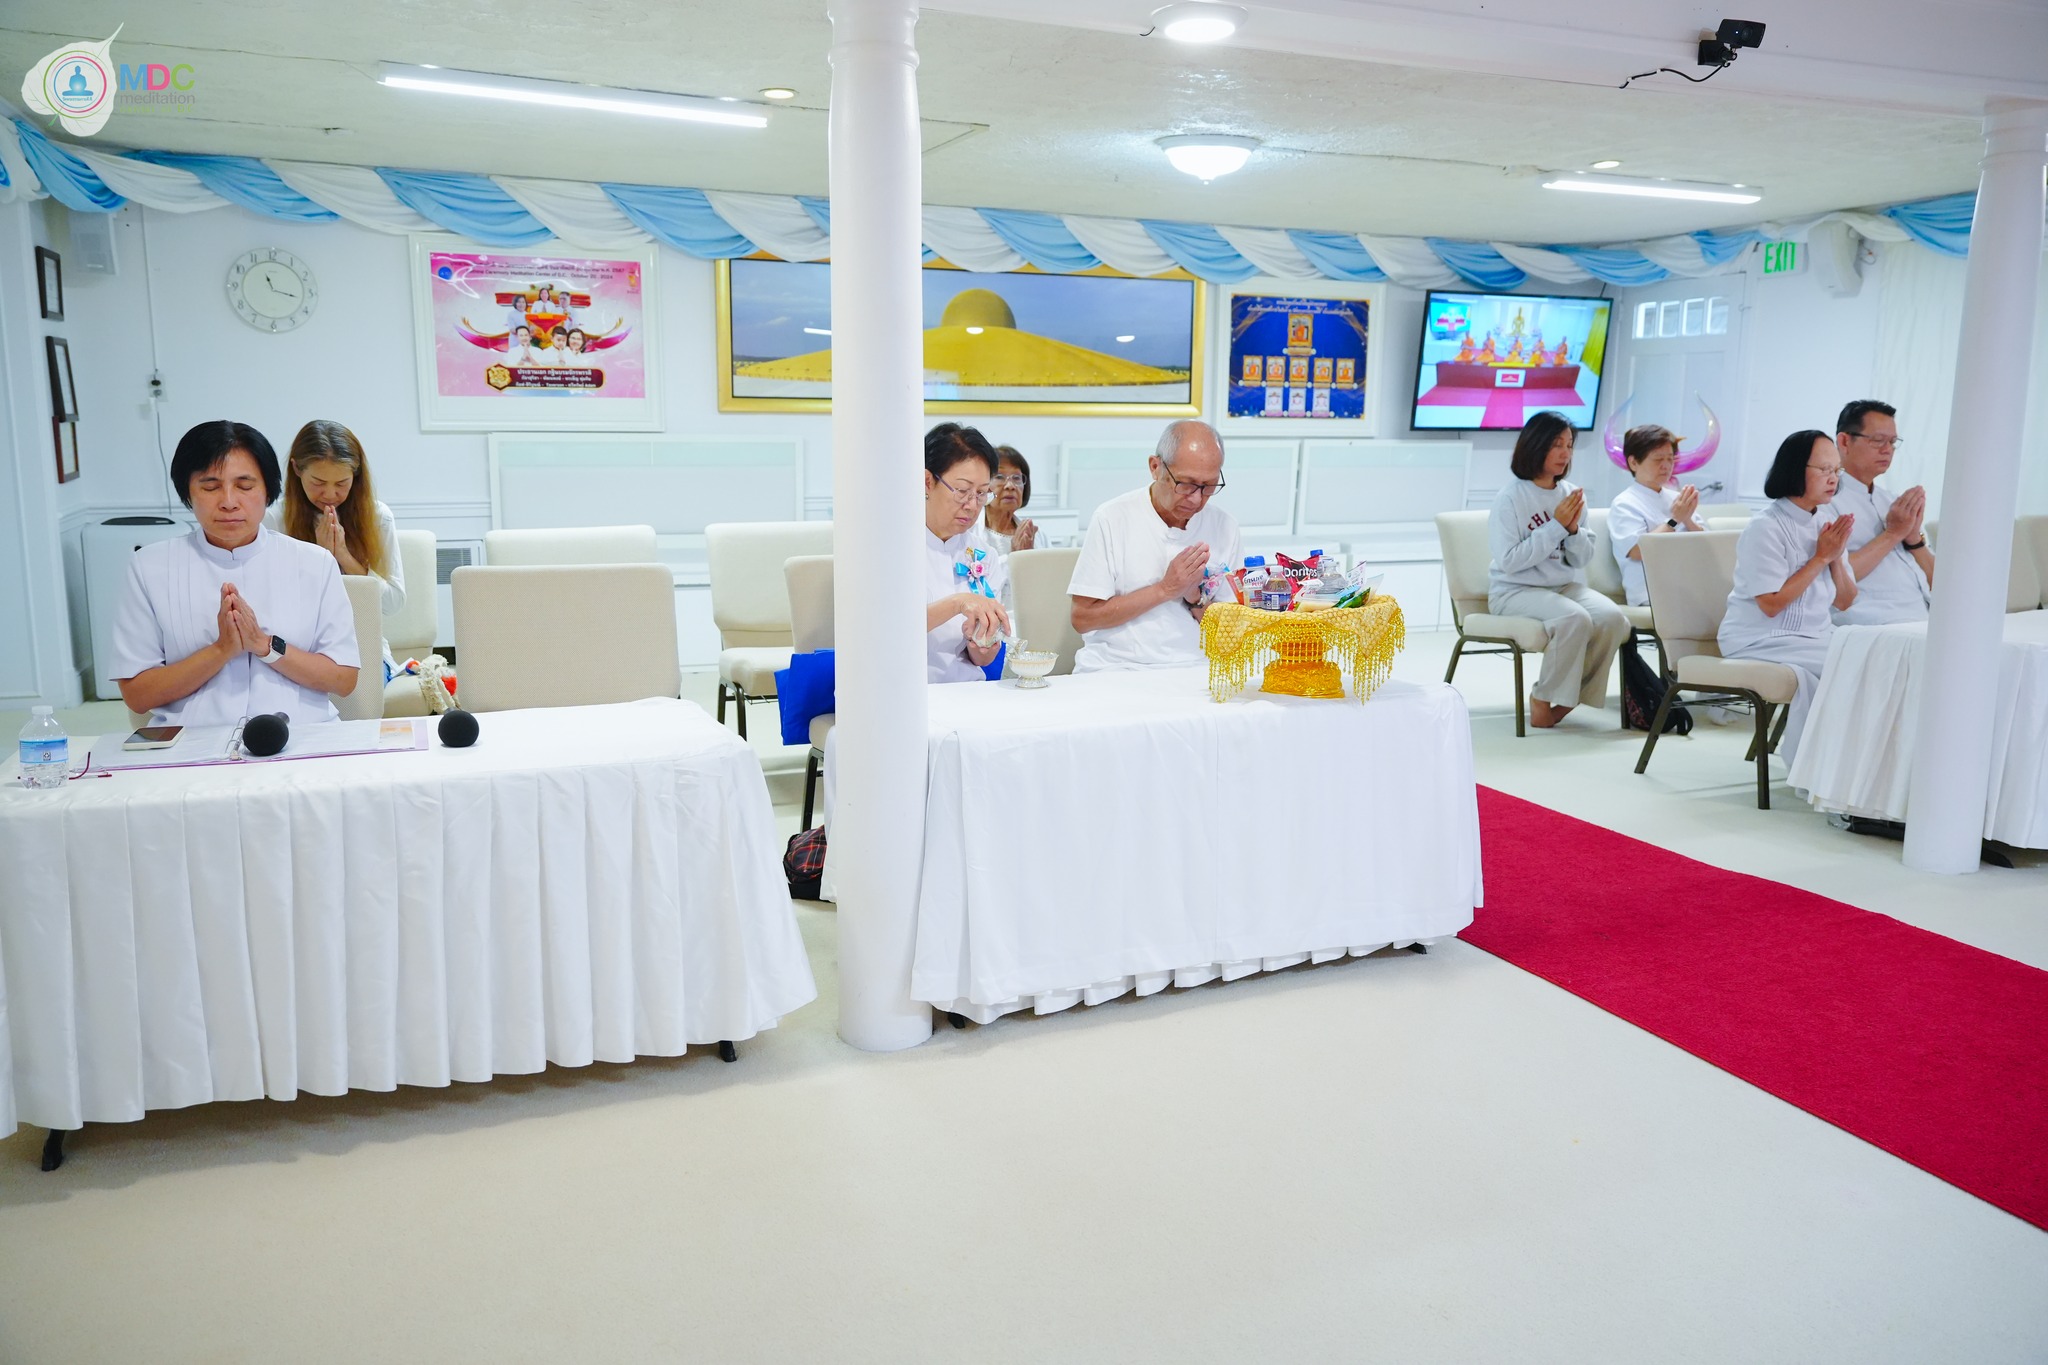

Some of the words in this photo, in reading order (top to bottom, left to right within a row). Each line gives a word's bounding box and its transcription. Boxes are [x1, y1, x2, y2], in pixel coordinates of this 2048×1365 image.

[268, 250, 278, 262] 12
[1764, 241, 1796, 274] EXIT
[1284, 566, 1318, 577] Doritos
